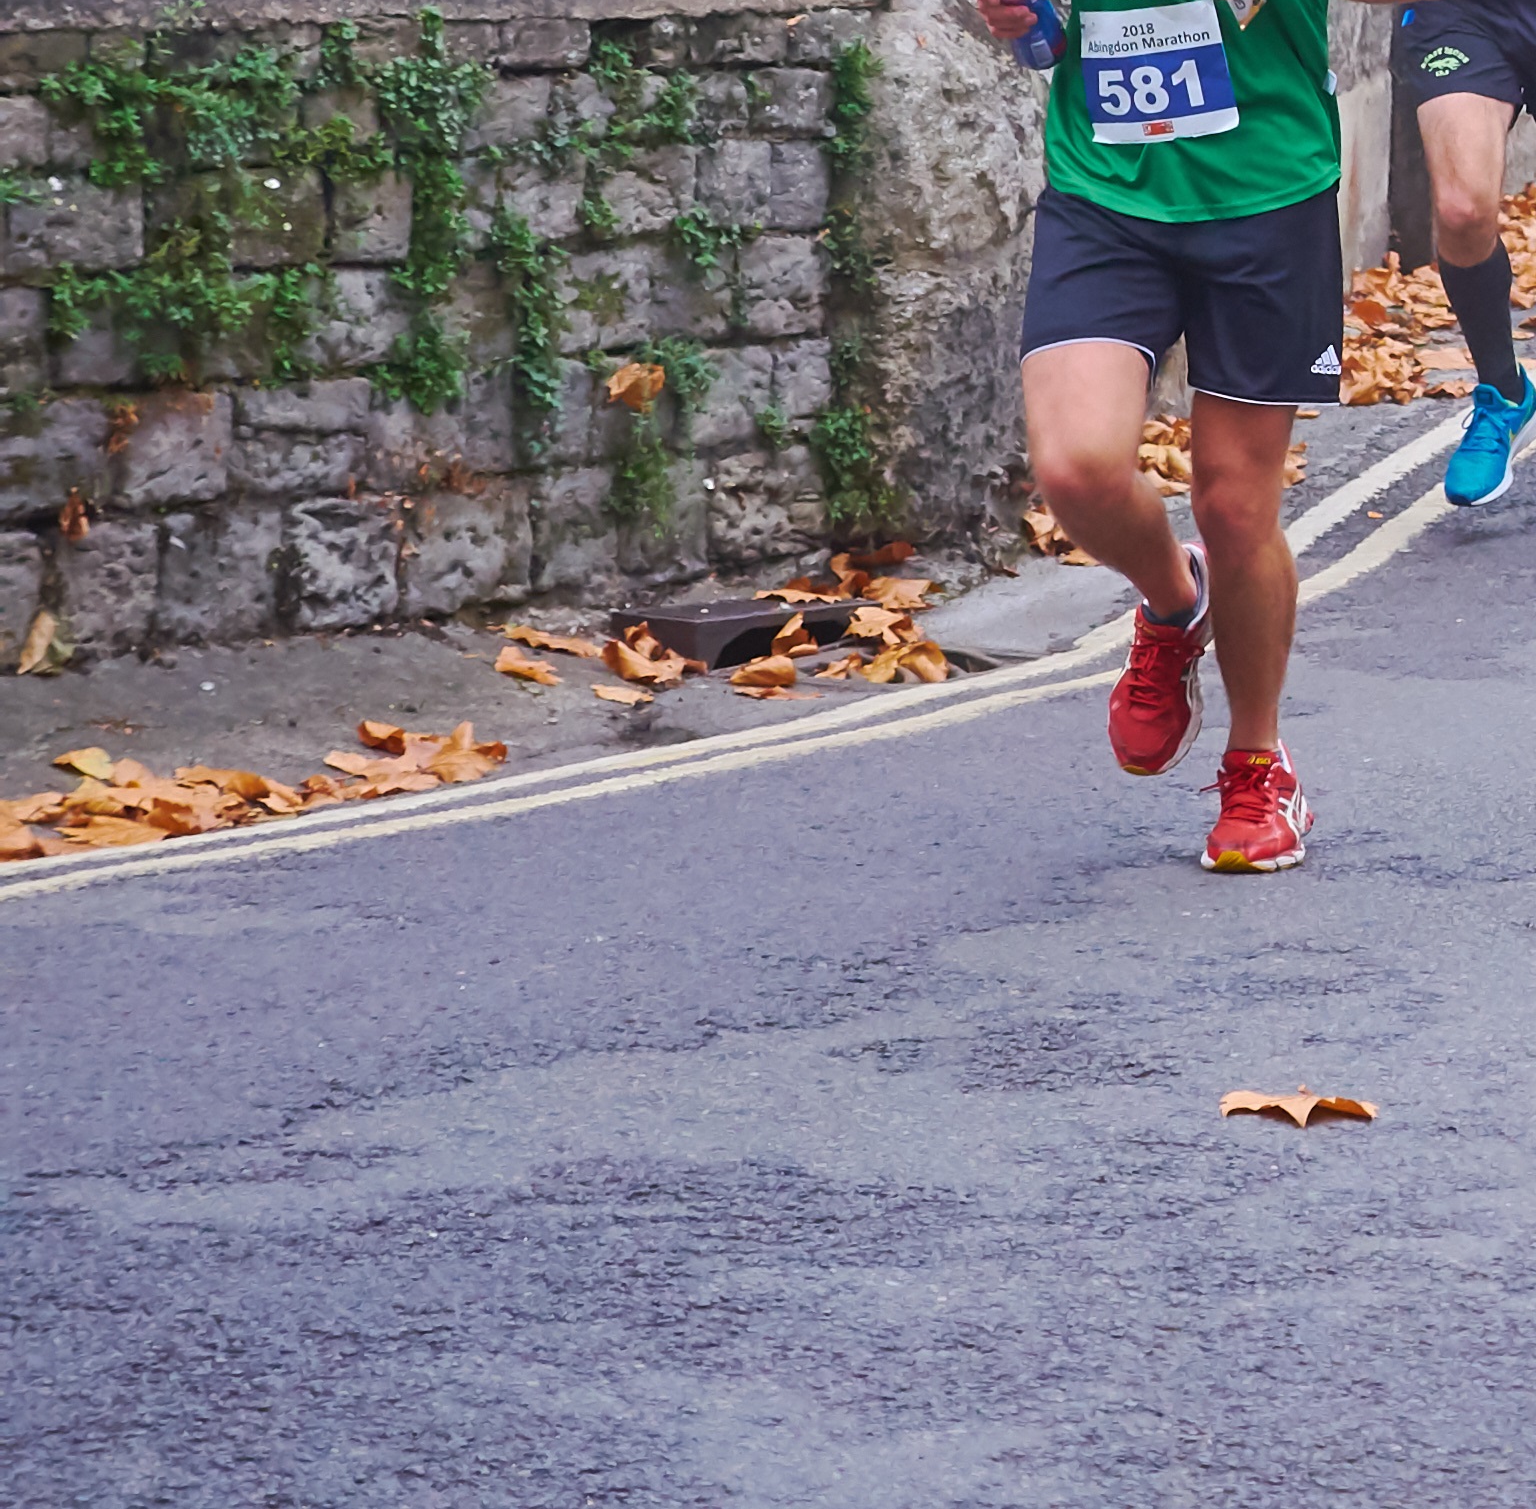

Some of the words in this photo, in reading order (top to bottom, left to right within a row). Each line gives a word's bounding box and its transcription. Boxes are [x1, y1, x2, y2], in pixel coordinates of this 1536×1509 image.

[1088, 39, 1138, 56] Abingdon
[1142, 30, 1210, 50] Marathon
[1121, 22, 1155, 38] 2018
[1098, 59, 1205, 116] 581
